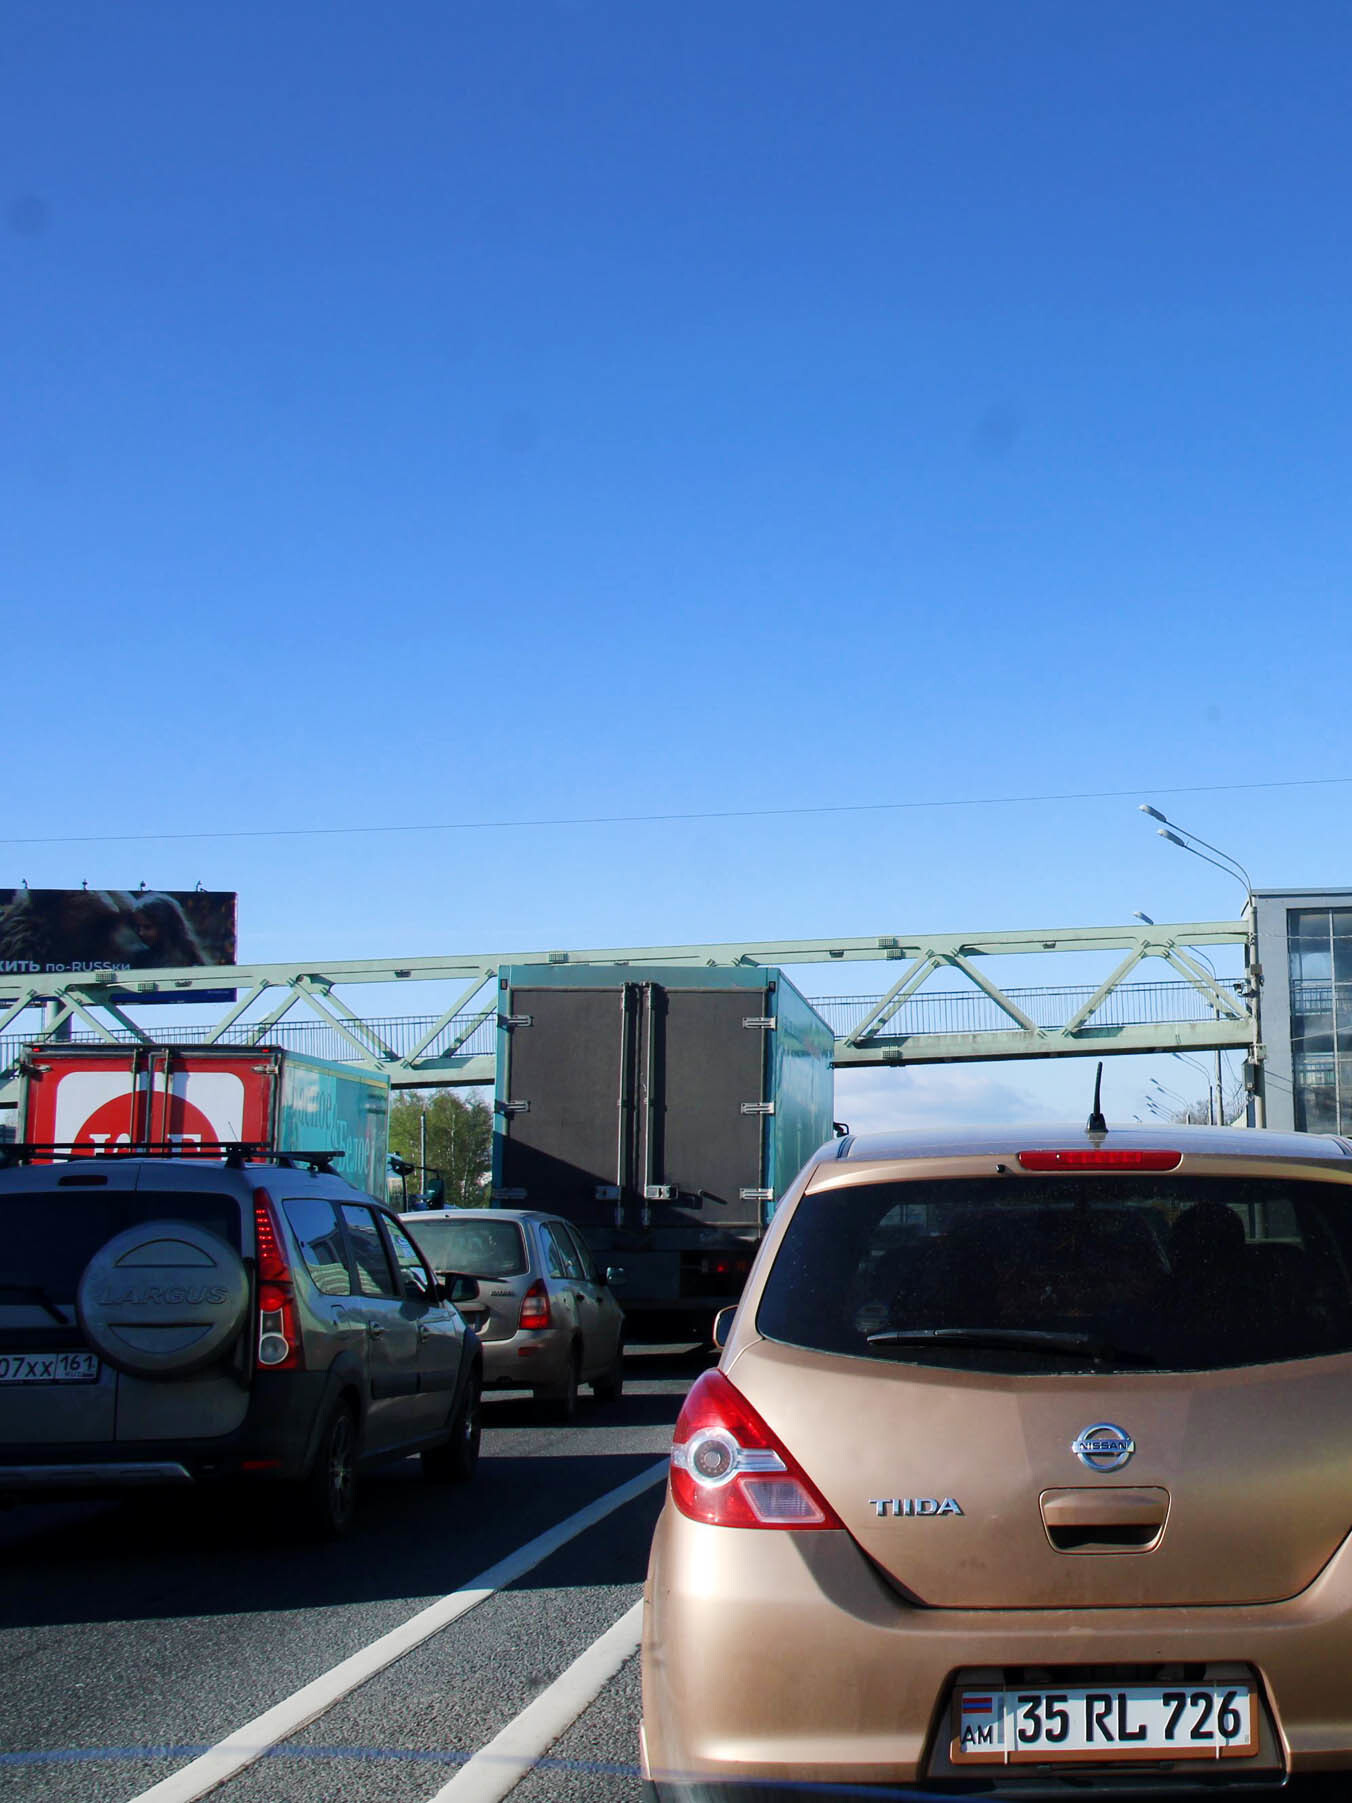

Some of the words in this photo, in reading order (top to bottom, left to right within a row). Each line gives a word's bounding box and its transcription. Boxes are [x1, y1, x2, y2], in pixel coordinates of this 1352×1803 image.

[0, 960, 41, 972] ИТЬ
[97, 1287, 229, 1305] LARGUS
[60, 1355, 94, 1371] 161
[1080, 1441, 1127, 1450] NISSAN
[868, 1497, 964, 1516] TIIDA
[961, 1725, 993, 1745] AM
[1017, 1694, 1069, 1743] 35
[1085, 1693, 1147, 1742] RL
[1162, 1690, 1241, 1740] 726
